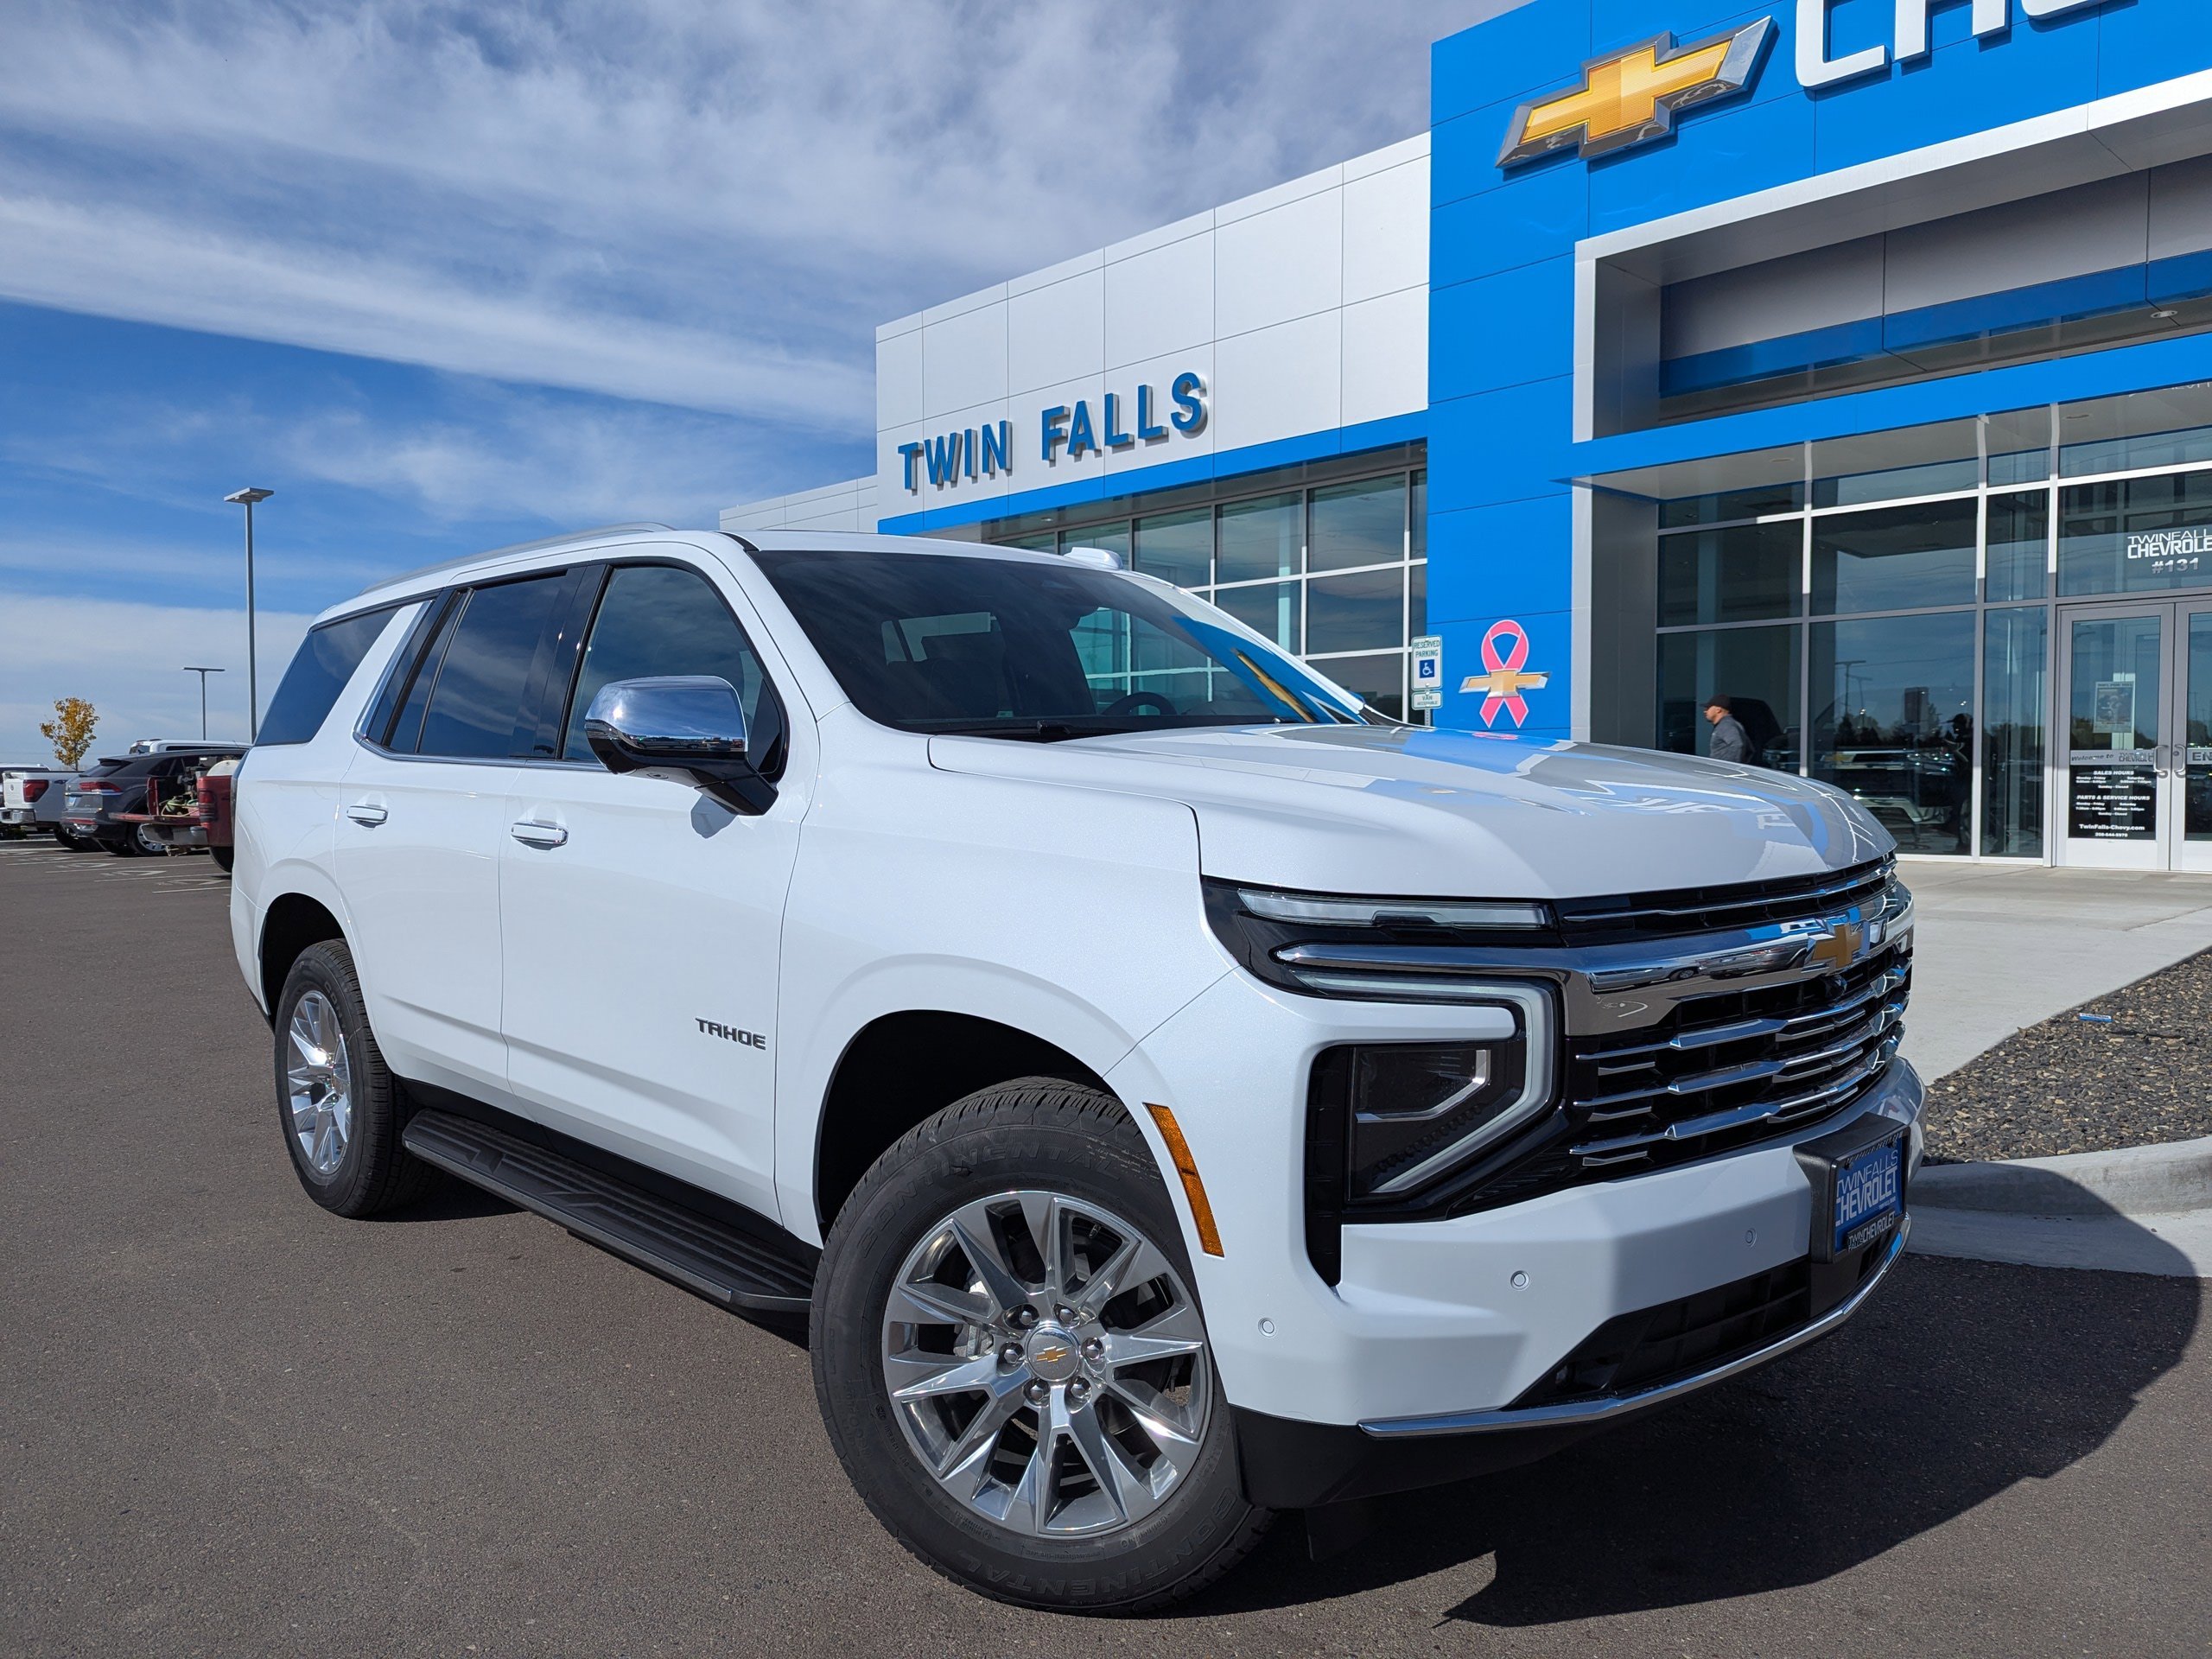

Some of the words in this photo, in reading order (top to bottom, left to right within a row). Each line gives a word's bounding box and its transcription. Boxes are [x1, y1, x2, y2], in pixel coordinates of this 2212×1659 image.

[898, 420, 1013, 491] TWIN
[1041, 372, 1207, 461] FALLS
[2127, 528, 2212, 545] TWINFALL
[2127, 537, 2212, 559] CHEVROLE
[2152, 557, 2199, 574] #131
[1413, 640, 1440, 649] RESERVED
[695, 1017, 766, 1051] TAHOE
[1836, 1149, 1898, 1198] TWINFALLS
[1862, 1211, 1896, 1242] CHEVROLET
